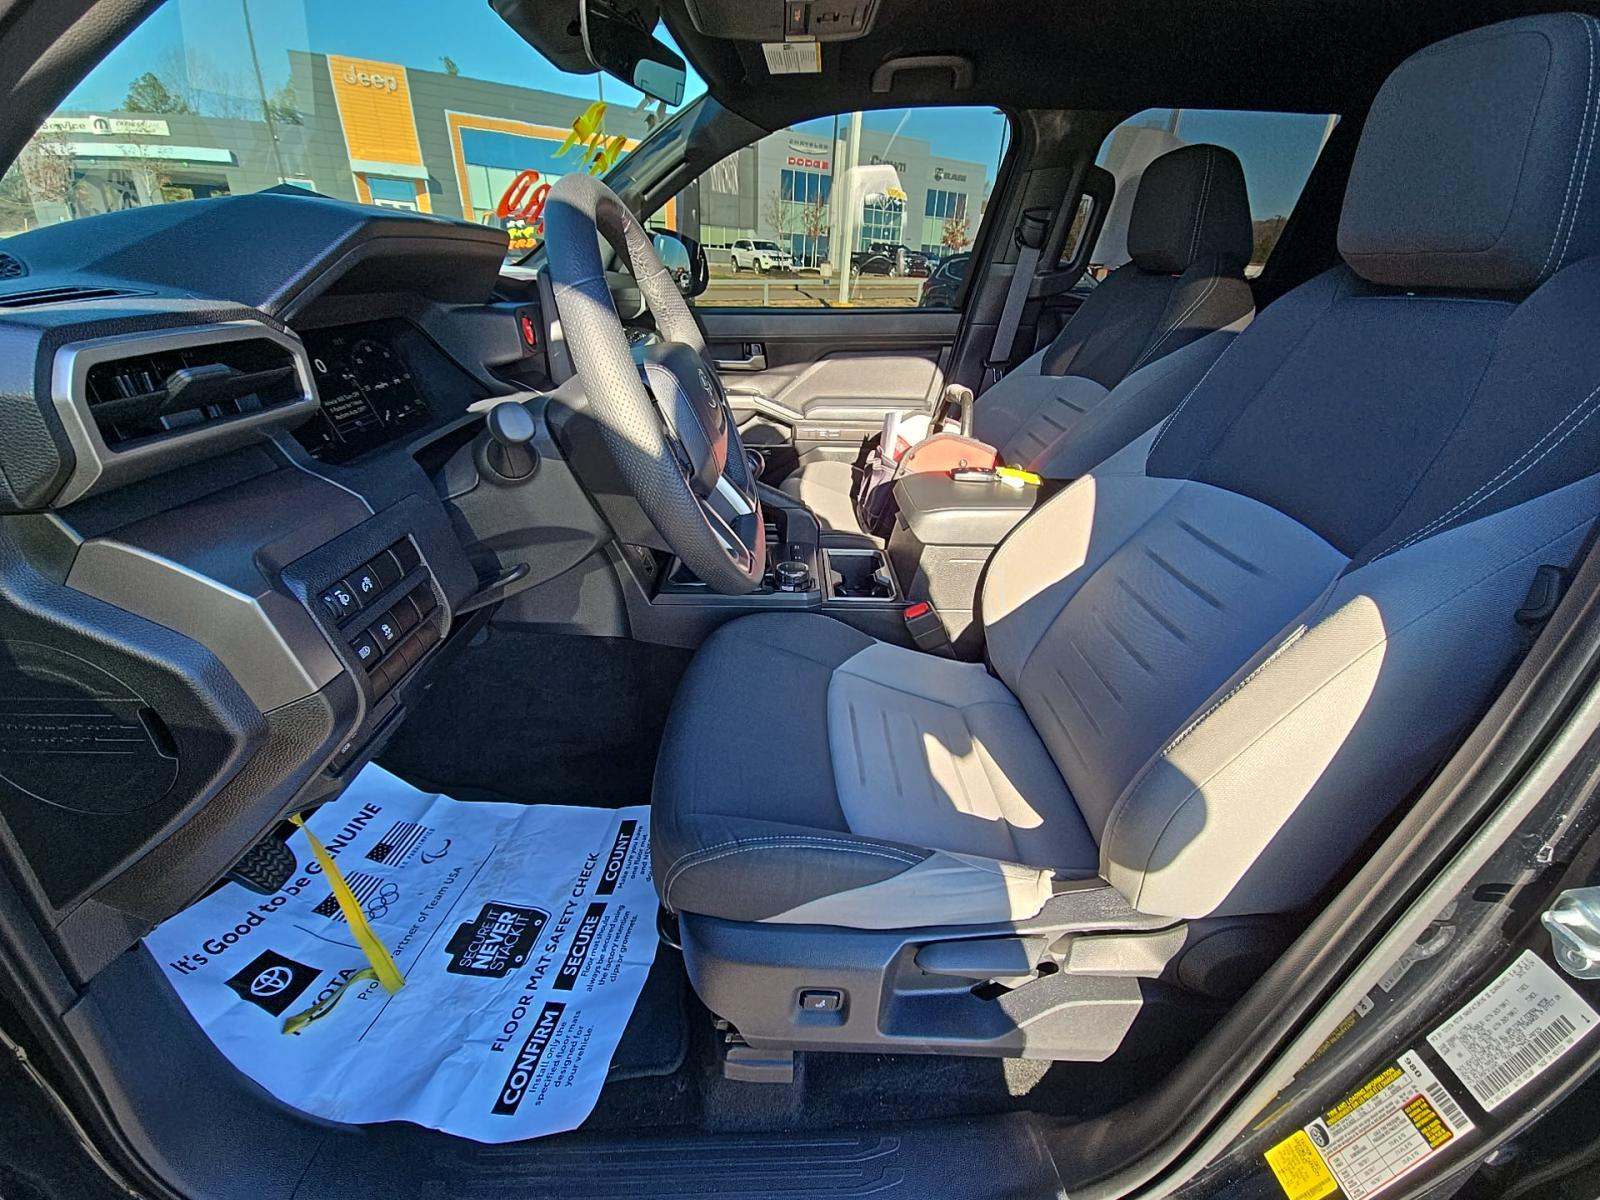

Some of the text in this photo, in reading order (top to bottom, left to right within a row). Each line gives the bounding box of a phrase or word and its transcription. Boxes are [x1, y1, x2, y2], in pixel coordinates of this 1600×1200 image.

[344, 64, 397, 93] Jeep
[787, 156, 829, 169] DODGE
[605, 833, 631, 881] COUNT
[169, 802, 382, 975] It's Good to be GNUINE
[391, 924, 420, 959] artner
[418, 911, 429, 923] of
[425, 884, 449, 910] Team
[447, 867, 463, 884] USA
[459, 908, 500, 967] SECURE IT
[471, 911, 518, 969] NEVER
[490, 914, 529, 971] STACK IT
[491, 852, 600, 1052] FLOOR MAT SAFETY CHECK
[563, 915, 599, 976] SECURE
[581, 915, 610, 977] Floor mat should
[586, 965, 601, 992] always
[602, 924, 616, 953] secured
[613, 904, 626, 923] using
[598, 910, 630, 986] the factory retention
[610, 963, 622, 982] clips
[503, 1011, 560, 1105] CONFIRM
[529, 1021, 568, 1092] Install only the
[535, 1010, 581, 1106] specified floor mats
[555, 1026, 584, 1088] designed for
[565, 1064, 579, 1088] your
